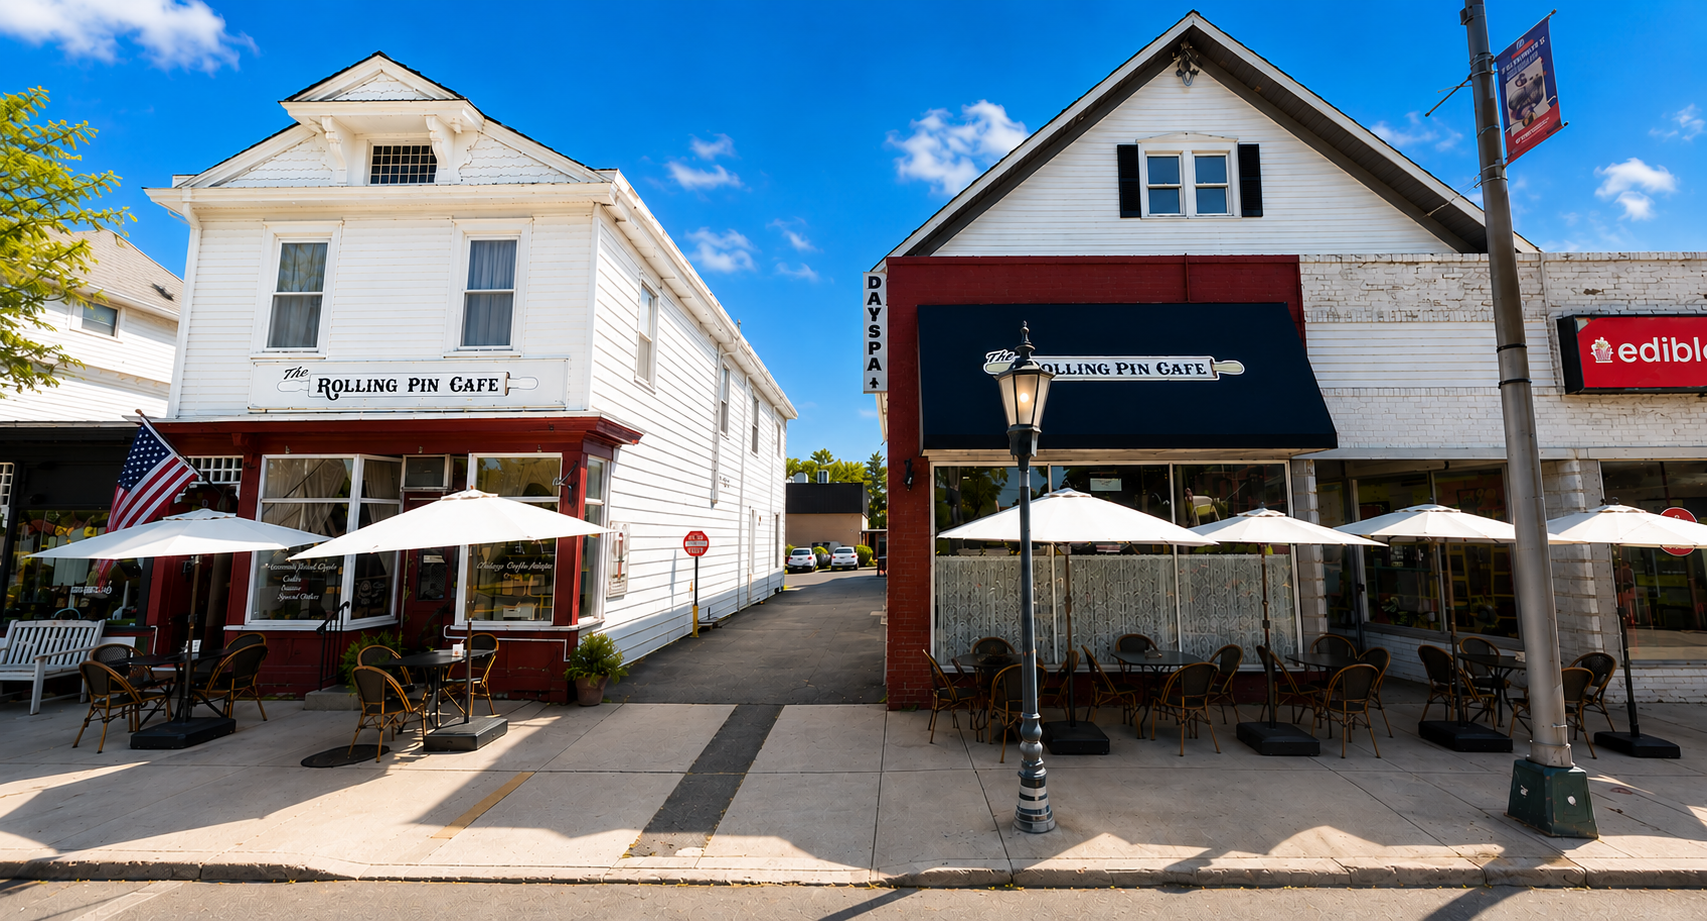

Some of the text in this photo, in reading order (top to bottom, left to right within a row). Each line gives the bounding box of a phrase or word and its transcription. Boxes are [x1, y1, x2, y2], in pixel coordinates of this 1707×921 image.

[1617, 336, 1707, 363] edibl
[283, 366, 309, 380] The
[1035, 360, 1208, 376] OLLING PIN CAFE
[316, 376, 499, 401] ROLLING PIN CAFE
